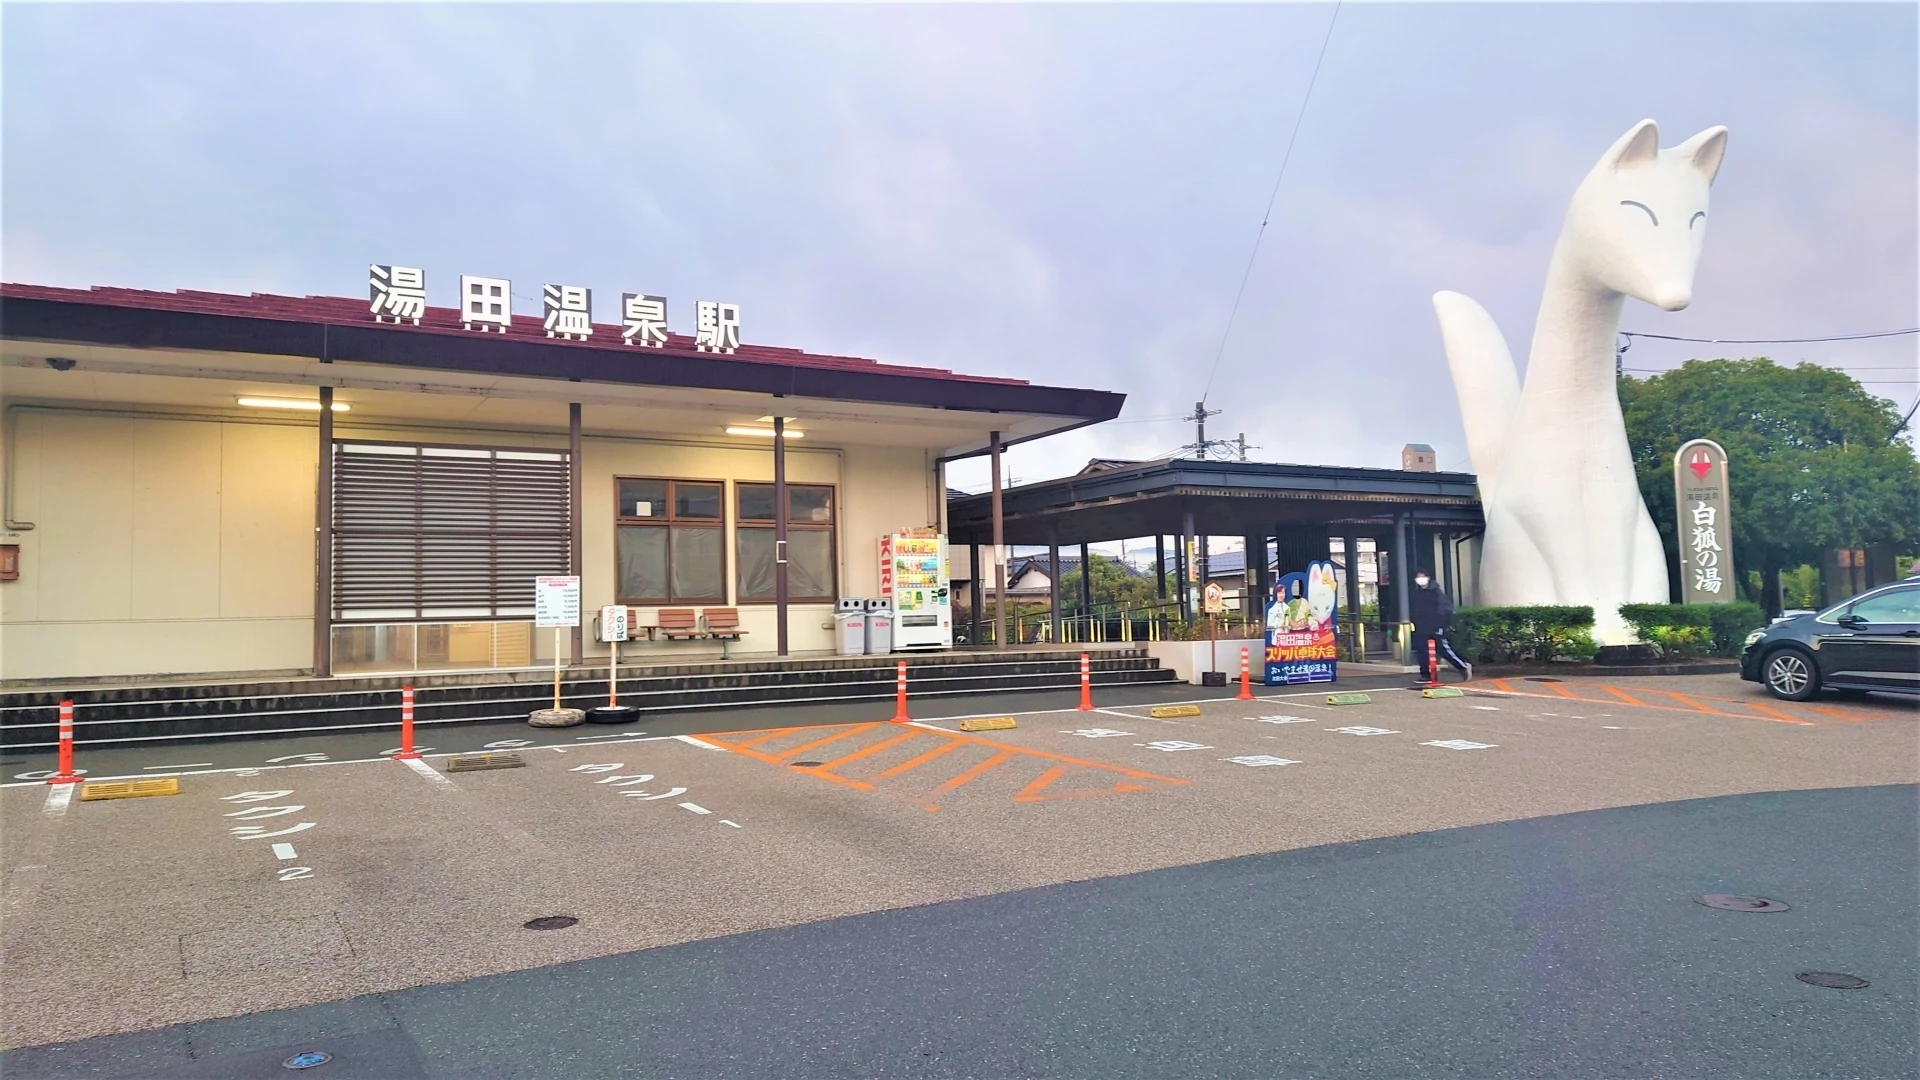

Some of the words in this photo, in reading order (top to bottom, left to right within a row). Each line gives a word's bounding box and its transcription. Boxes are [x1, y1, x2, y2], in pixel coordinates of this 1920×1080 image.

[369, 264, 740, 349] 湯田温泉駅
[1691, 501, 1723, 594] 白狐の湯
[881, 539, 893, 600] KIRI
[607, 608, 615, 640] タクシー
[616, 616, 625, 639] のりば
[1276, 633, 1313, 647] 湯田温泉
[1266, 645, 1336, 661] スリッパ卓球大会
